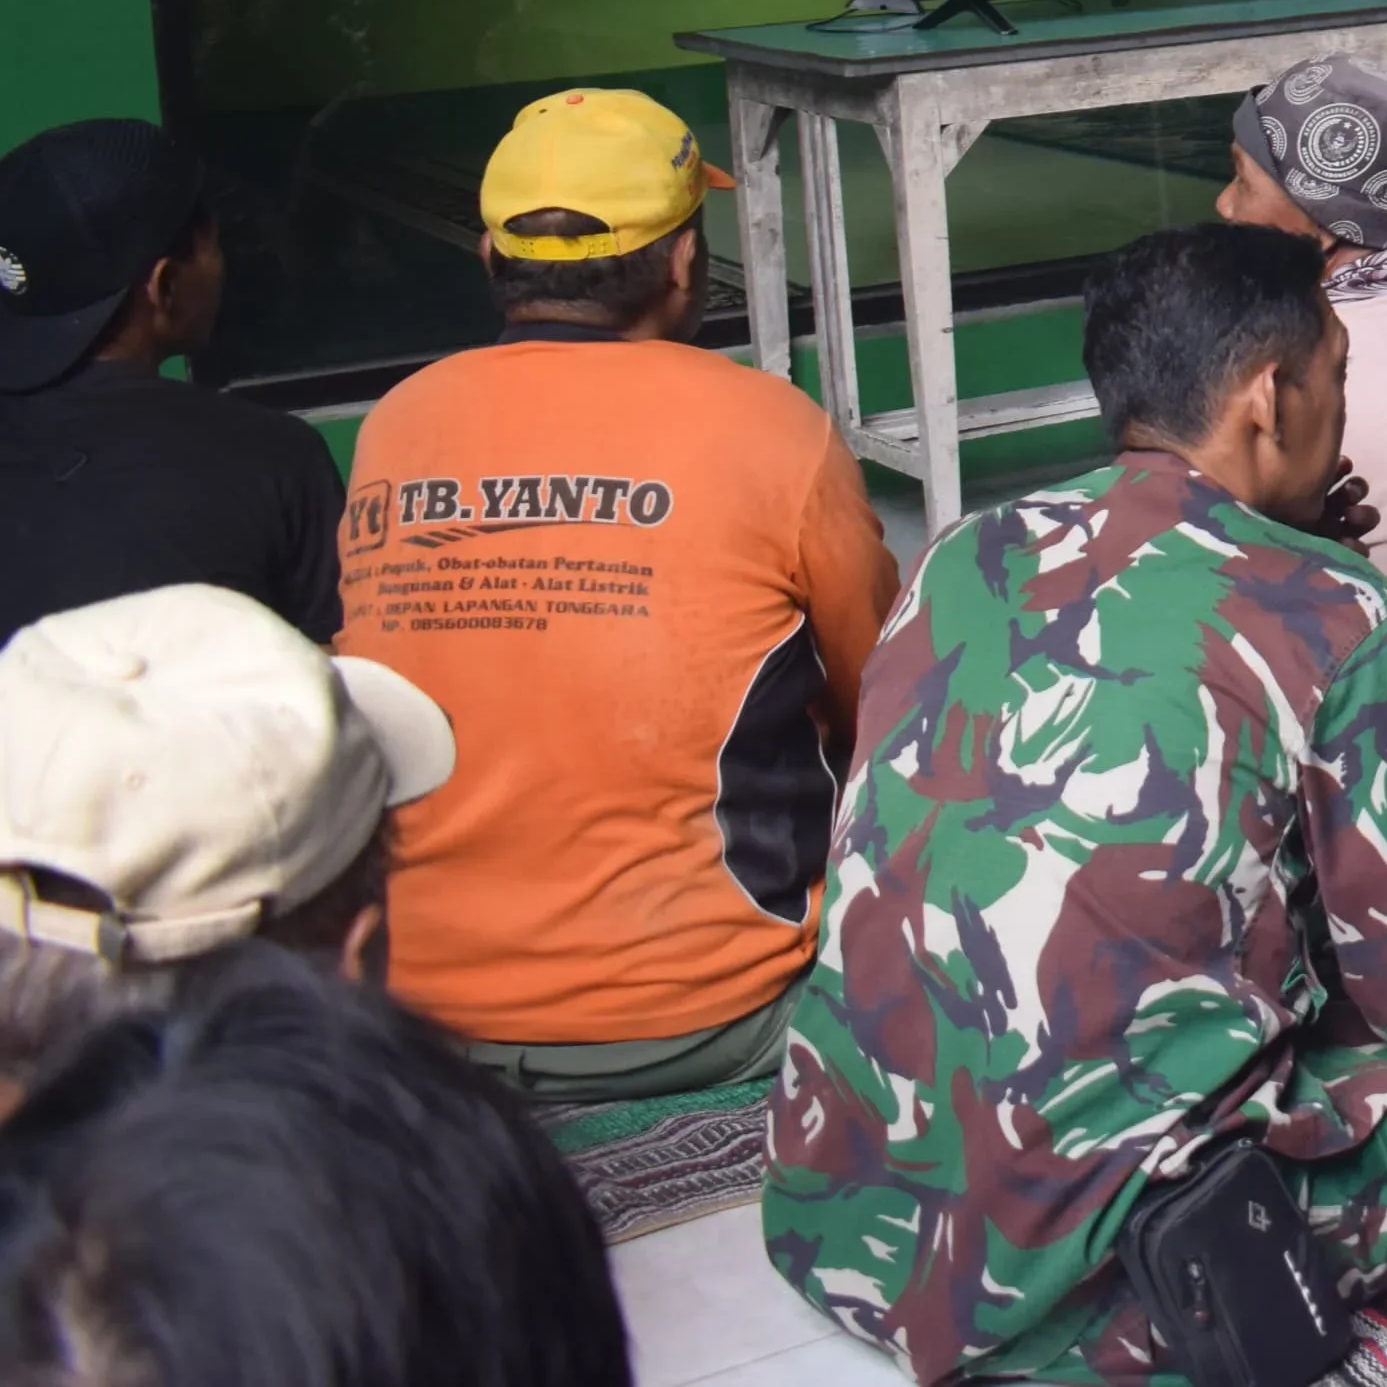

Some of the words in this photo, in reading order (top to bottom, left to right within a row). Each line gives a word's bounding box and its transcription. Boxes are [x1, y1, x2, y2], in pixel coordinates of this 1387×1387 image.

[437, 556, 548, 571] Obat-obatan
[554, 556, 654, 577] Pertanian
[459, 577, 474, 592] &
[479, 576, 517, 591] Alat
[532, 576, 573, 591] Alat
[578, 577, 650, 596] Listrik
[443, 599, 538, 614] LAPANGAN
